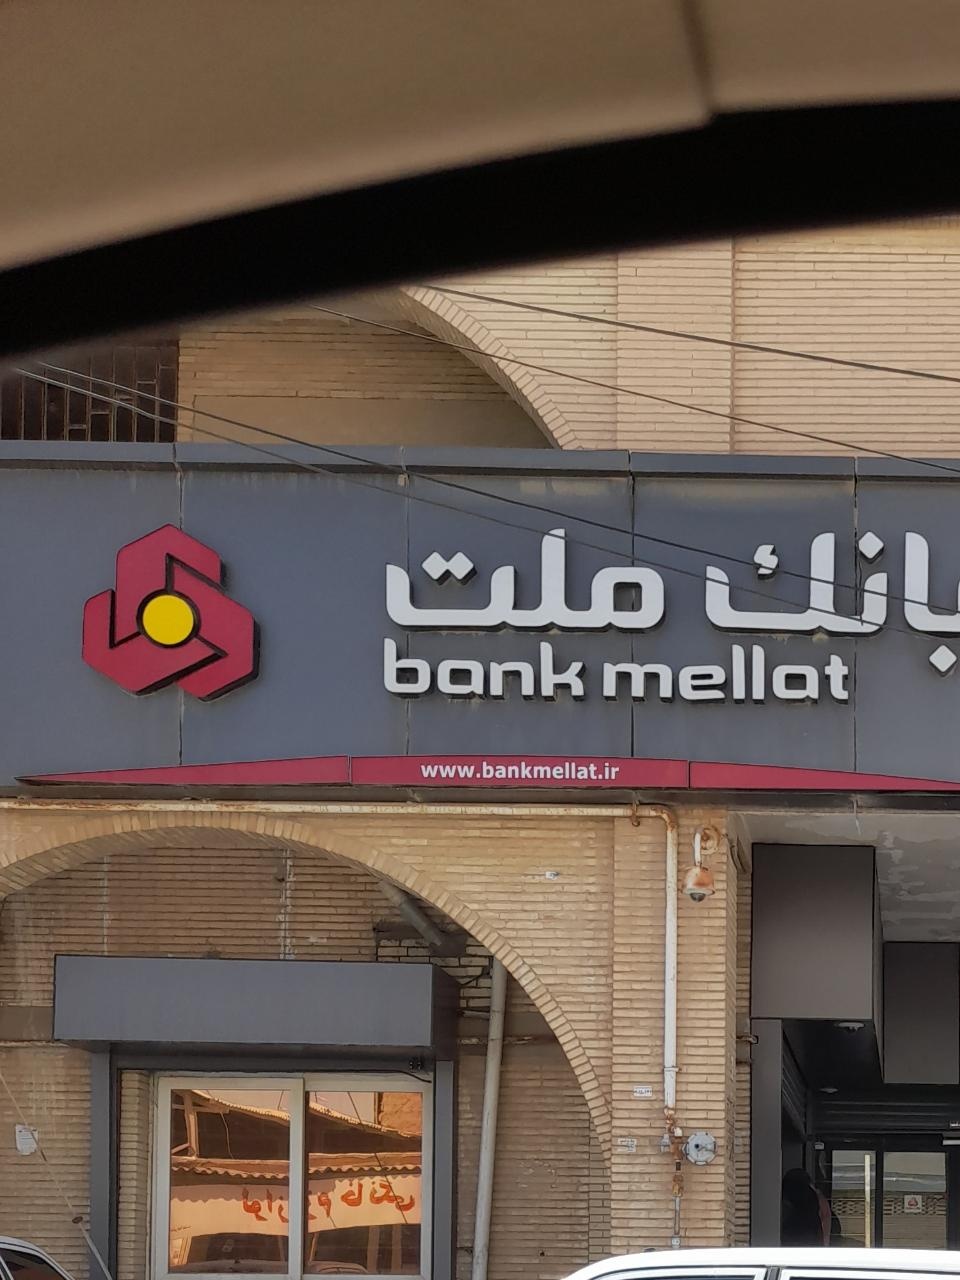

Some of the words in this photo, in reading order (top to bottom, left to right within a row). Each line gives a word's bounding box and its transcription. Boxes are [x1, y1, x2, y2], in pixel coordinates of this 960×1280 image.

[385, 528, 666, 630] ملت
[384, 637, 586, 697] bank
[602, 644, 850, 701] mellat
[420, 761, 620, 781] www.bankmellat.ir
